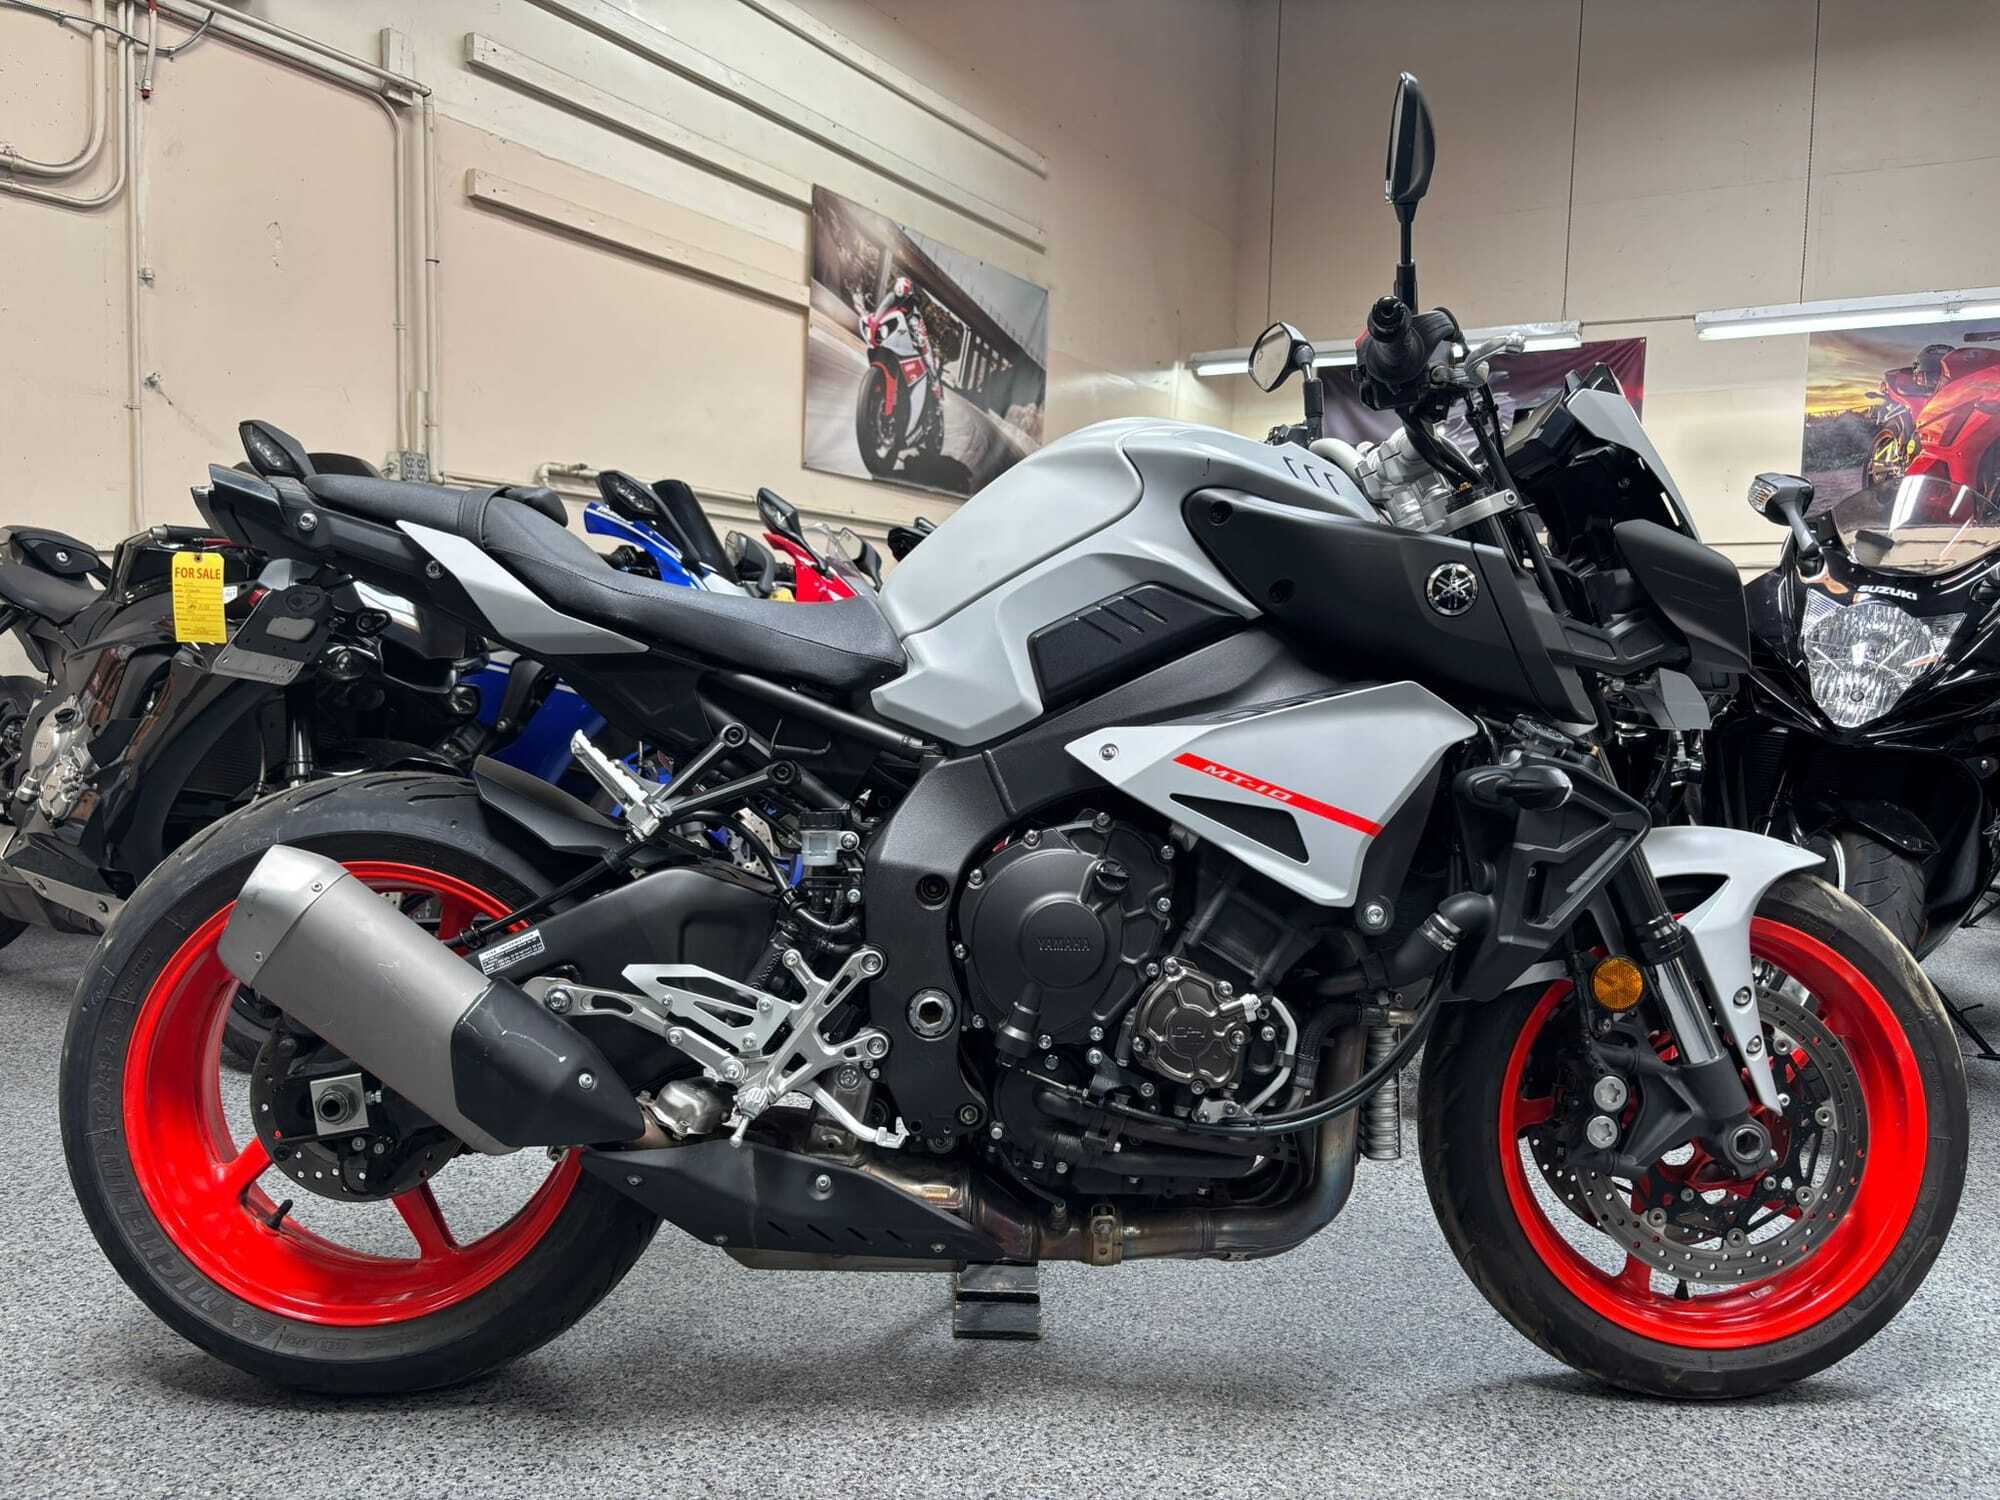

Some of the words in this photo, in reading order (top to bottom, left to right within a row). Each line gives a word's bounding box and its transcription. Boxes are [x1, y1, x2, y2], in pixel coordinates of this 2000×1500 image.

[175, 567, 194, 579] FOR
[196, 567, 221, 580] SALE
[1857, 585, 1918, 600] SUZUKI
[1202, 765, 1292, 801] MT-10
[1037, 936, 1090, 952] YAMAHA
[97, 1150, 225, 1317] MICHELIN
